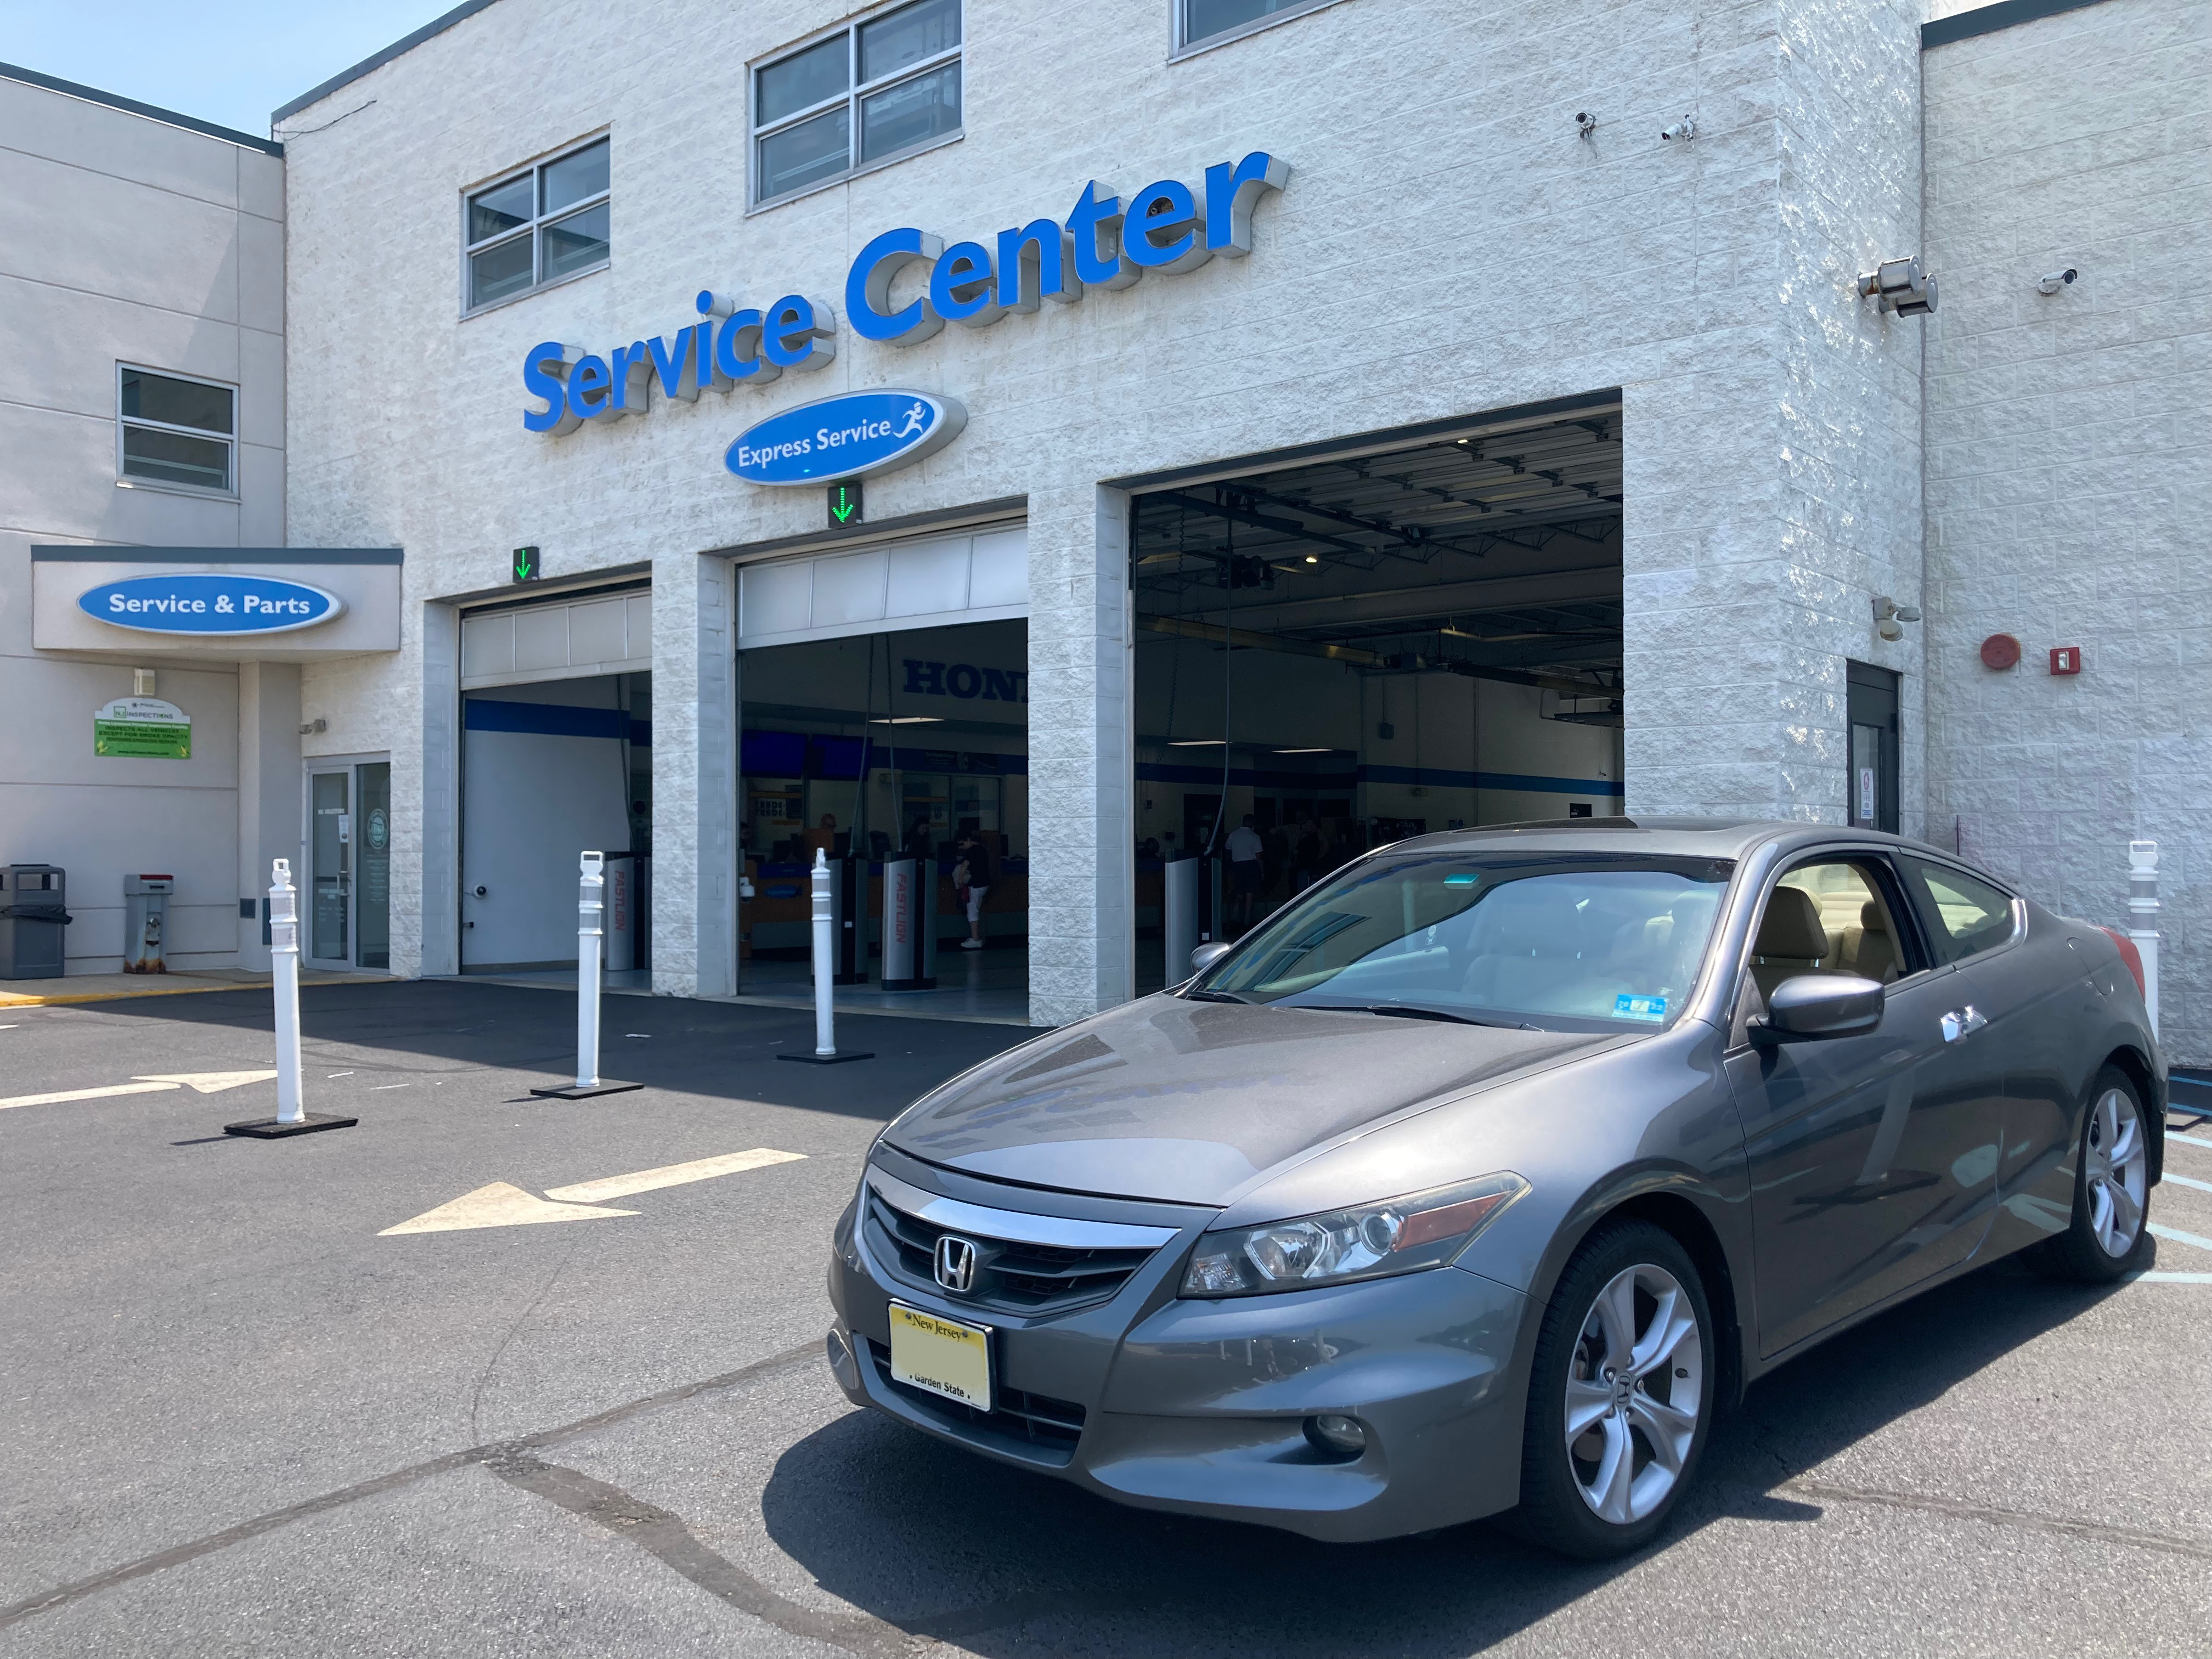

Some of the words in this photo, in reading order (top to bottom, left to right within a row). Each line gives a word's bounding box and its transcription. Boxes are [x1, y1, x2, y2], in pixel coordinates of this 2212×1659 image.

[523, 290, 814, 433] Service
[845, 152, 1271, 343] Center
[738, 438, 810, 469] Express
[816, 419, 891, 450] Service
[109, 594, 206, 613] Service
[214, 594, 235, 613] &
[244, 595, 311, 614] Parts
[896, 873, 907, 944] FASTLIGN
[1618, 1000, 1629, 1009] 20
[1650, 1002, 1663, 1011] 22
[912, 1313, 934, 1330] New
[934, 1320, 961, 1342] Jersey
[914, 1372, 941, 1390] Garden
[944, 1381, 964, 1398] State
